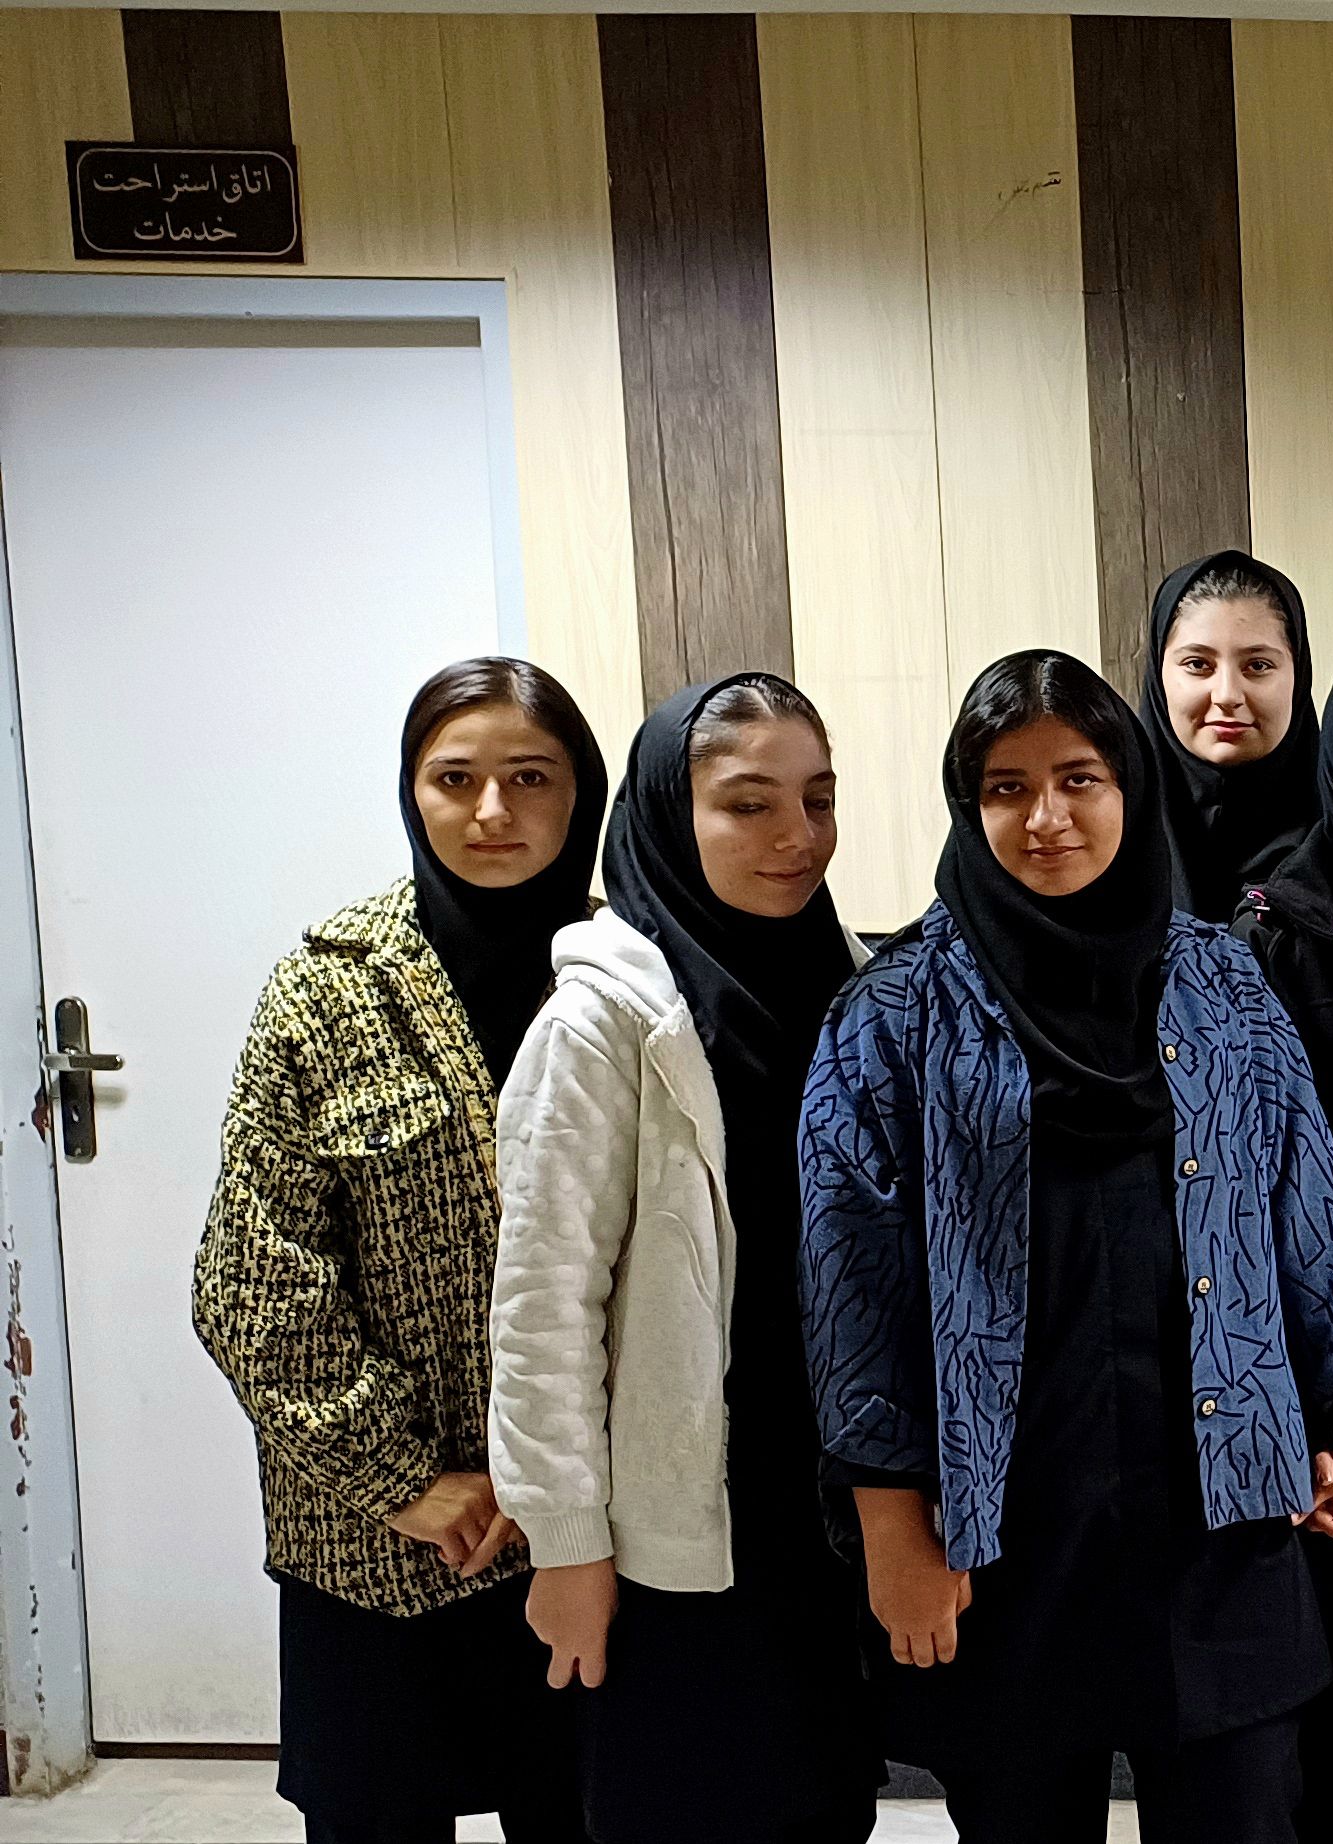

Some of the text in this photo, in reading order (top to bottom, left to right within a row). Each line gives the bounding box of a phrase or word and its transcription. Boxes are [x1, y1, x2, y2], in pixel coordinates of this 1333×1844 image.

[93, 162, 271, 204] اتاق استراحت
[133, 211, 237, 242] خدمات
